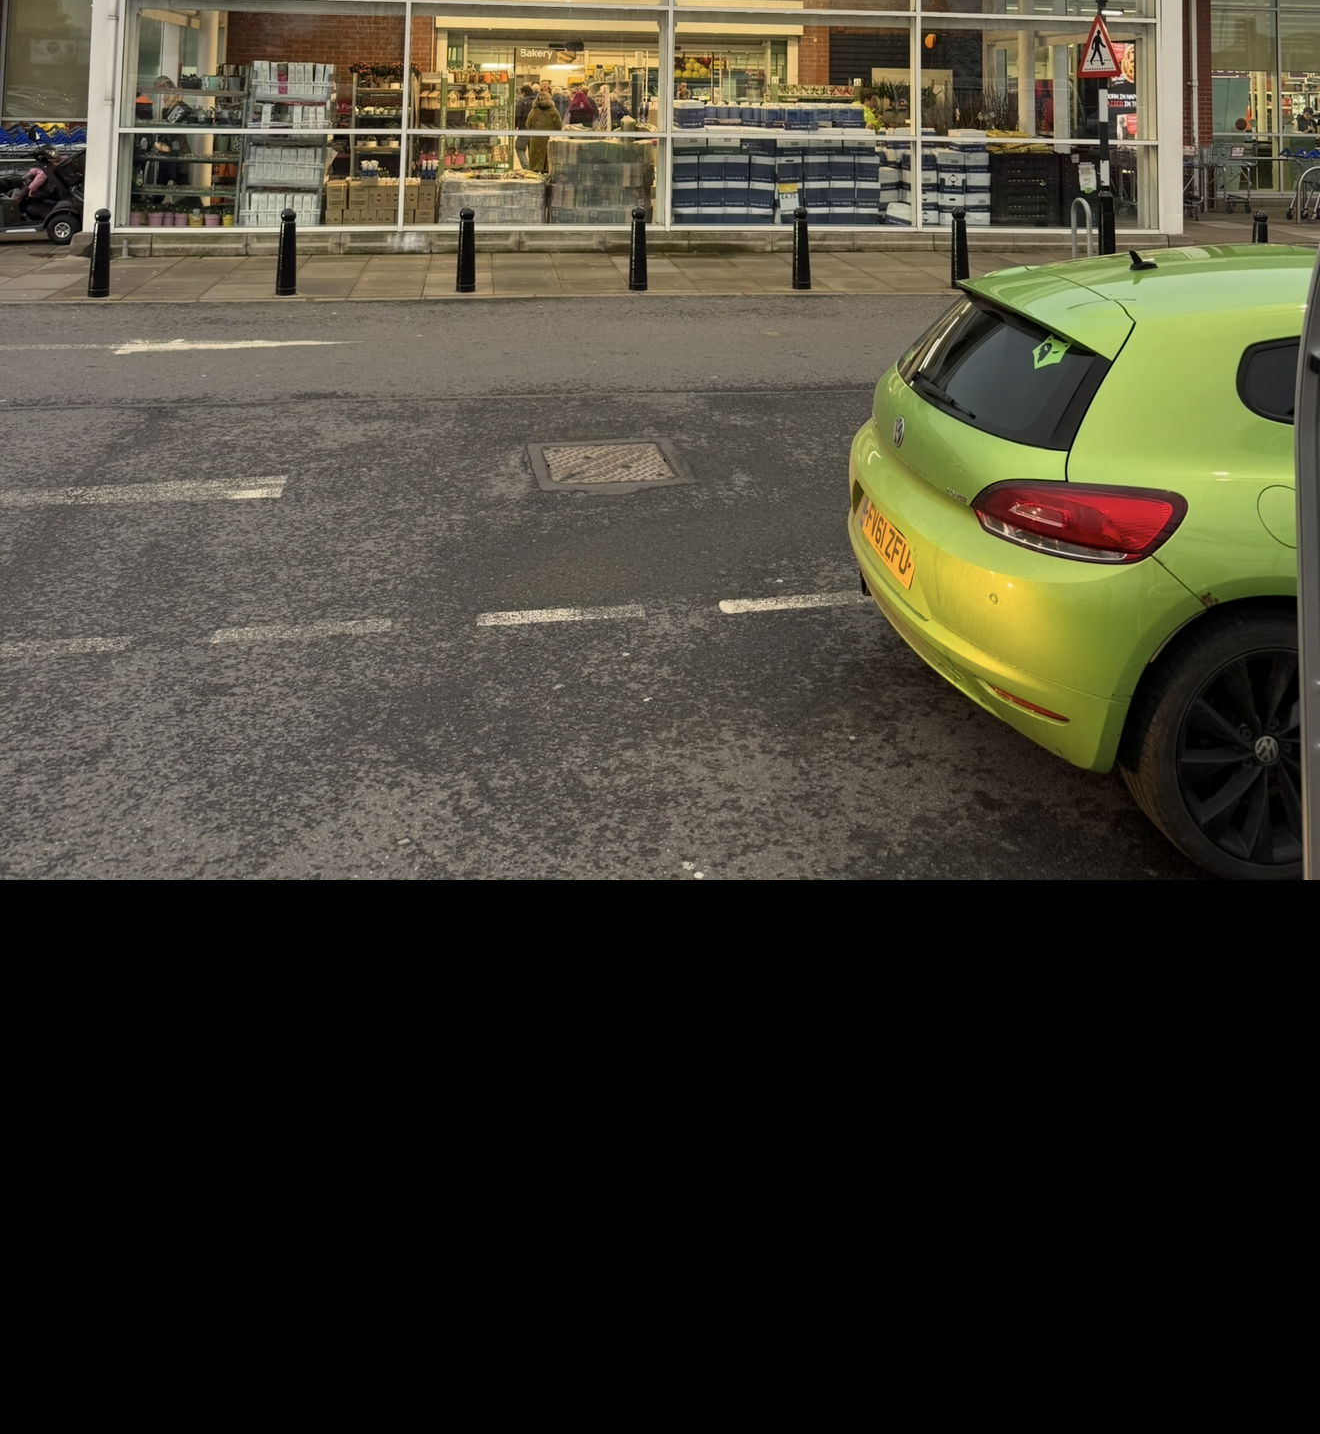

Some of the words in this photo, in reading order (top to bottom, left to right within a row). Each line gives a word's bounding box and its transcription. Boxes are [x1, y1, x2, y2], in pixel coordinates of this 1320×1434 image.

[520, 48, 553, 60] Bakery
[866, 503, 888, 549] FV61
[884, 528, 911, 575] ZFU
